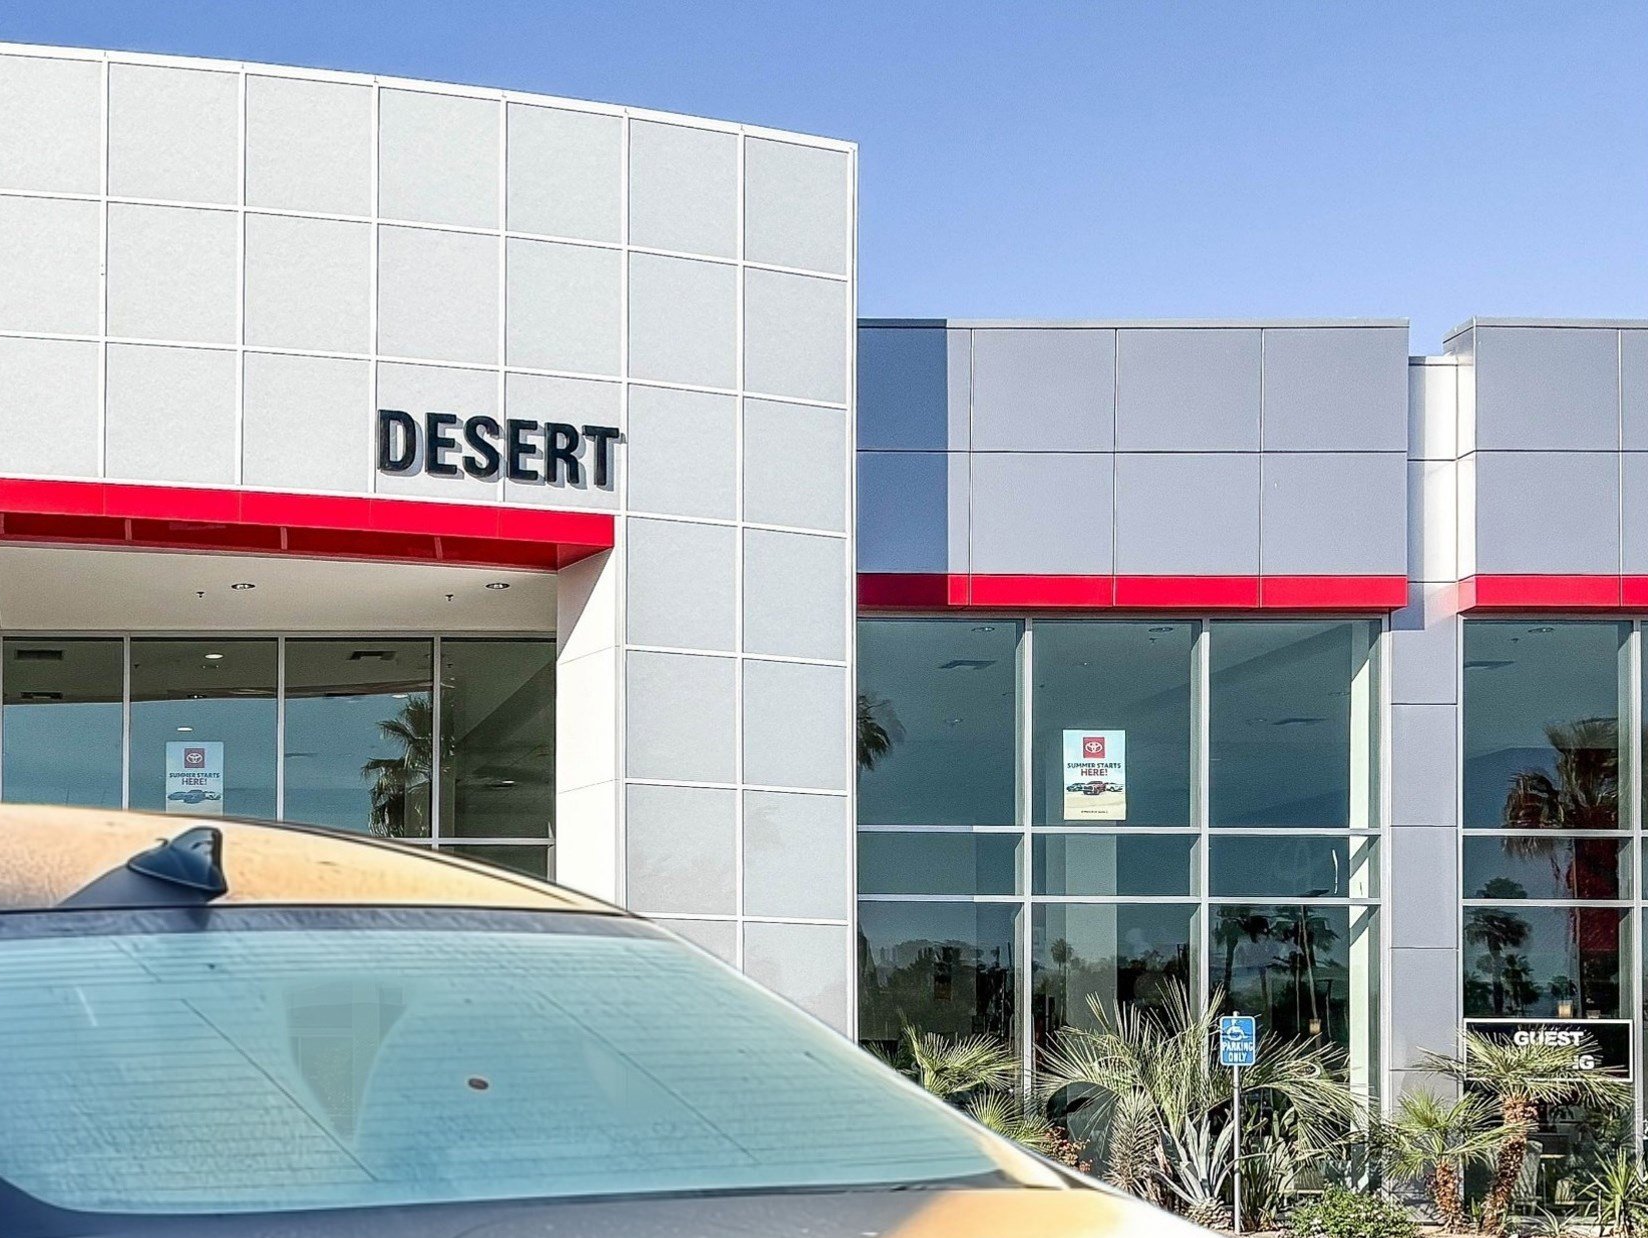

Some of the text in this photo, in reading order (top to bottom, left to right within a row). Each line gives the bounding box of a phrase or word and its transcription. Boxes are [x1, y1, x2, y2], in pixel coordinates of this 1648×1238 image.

[377, 408, 621, 487] DESERT
[1080, 768, 1108, 776] HERE!
[1513, 1030, 1585, 1047] GUEST
[1222, 1041, 1253, 1052] PARKING
[1228, 1052, 1248, 1063] ONLY
